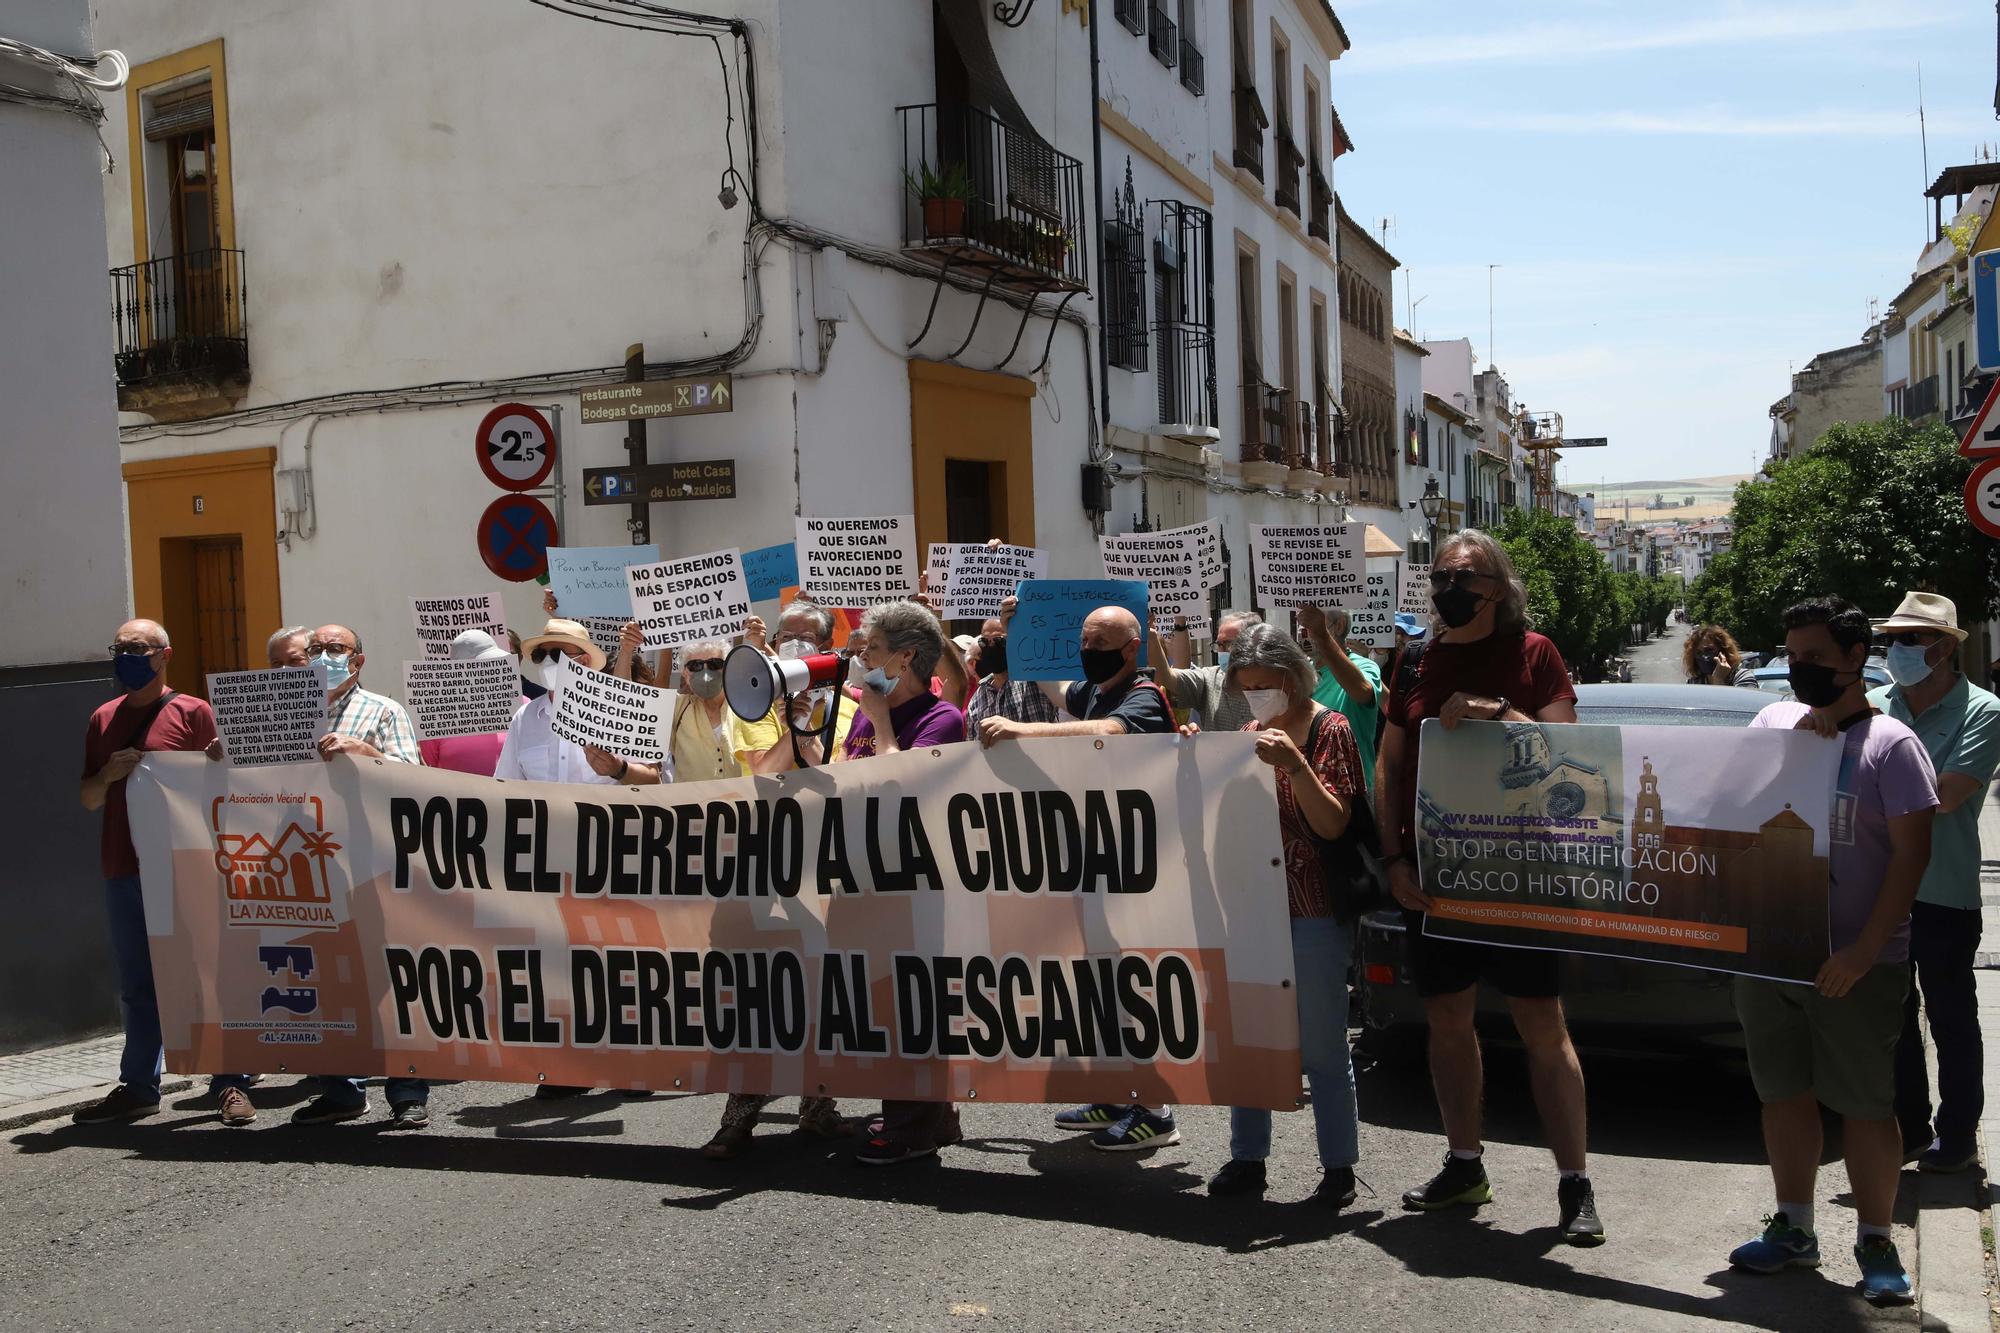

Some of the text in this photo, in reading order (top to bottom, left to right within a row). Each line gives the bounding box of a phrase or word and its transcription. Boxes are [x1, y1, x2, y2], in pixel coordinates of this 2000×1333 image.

[582, 386, 642, 402] restaurante
[696, 386, 707, 404] P
[582, 403, 673, 419] Bodegas Campos
[673, 466, 730, 479] hotel Casa
[606, 477, 616, 495] P
[650, 487, 663, 498] de
[667, 486, 683, 496] los
[807, 518, 898, 531] NO QUEREMOS
[1261, 526, 1347, 536] QUEREMOS QUE
[818, 534, 886, 546] QUE SIGAN
[1117, 539, 1183, 550] QUEREMOS
[1268, 538, 1340, 548] SE REVISE EL
[808, 549, 902, 561] FAVORECIENDO
[1014, 549, 1034, 558] QUE
[1103, 552, 1192, 563] QUE VUELVAN A
[1261, 549, 1351, 560] PEPCH DONDE SE
[631, 568, 650, 581] NO
[653, 553, 733, 578] QUEREMOS
[977, 556, 1012, 565] REVISE
[1014, 558, 1026, 567] EL
[1268, 562, 1344, 572] CONSIDERE EL
[809, 564, 902, 576] EL VACIADO DE
[955, 566, 1035, 579] PEPCH DONDE SE
[1106, 565, 1133, 576] VENIR
[635, 584, 663, 597] MÁS
[666, 570, 736, 593] ESPACIOS
[959, 577, 1012, 586] CONSIDERE
[1181, 579, 1190, 588] A
[1261, 573, 1356, 584] CASCO HISTÓRICO
[806, 579, 910, 591] RESIDENTES DEL
[1258, 584, 1363, 596] DE USO PREFERENTE
[652, 589, 722, 612] DE OCIO Y
[1155, 591, 1198, 602] CASCO
[415, 596, 489, 612] QUEREMOS QUE
[420, 611, 490, 626] SE NOS DEFINA
[638, 602, 748, 633] HOSTELERÍA EN
[1031, 616, 1047, 628] ES
[1352, 625, 1392, 634] CASCO
[641, 627, 707, 646] NUESTRA
[426, 643, 449, 654] COMO
[1018, 635, 1080, 661] CUÍD
[466, 659, 508, 669] DEFINITIVA
[464, 668, 500, 677] VIVIENDO
[501, 674, 517, 682] POR
[568, 660, 659, 698] NO QUEREMOS
[470, 683, 512, 693] EVOLUCIÓN
[575, 680, 644, 708] QUE SIGAN
[563, 687, 657, 722] FAVORECIENDO
[561, 700, 655, 735] EL VACIADO DE
[425, 726, 476, 737] CONVIVENCIA
[556, 711, 659, 747] RESIDENTES DEL
[551, 722, 588, 749] CASCO
[228, 793, 306, 804] Asociación Vecinal
[1469, 814, 1494, 825] SAN
[391, 789, 1157, 898] POR EL DERECHO A LA CIUDAD
[1435, 838, 1496, 860] STOP
[1505, 841, 1716, 876] GENTRIFICACIÓN
[1438, 868, 1659, 905] CASCO HISTÓRICO
[230, 905, 335, 922] LA AXERQUIA
[1440, 904, 1720, 941] CASCO HISTÓRICO PATRIMONIO DE LA HUMANIDAD EN RIESGO
[385, 946, 1200, 1060] POR EL DERECHO AL DESCANSO
